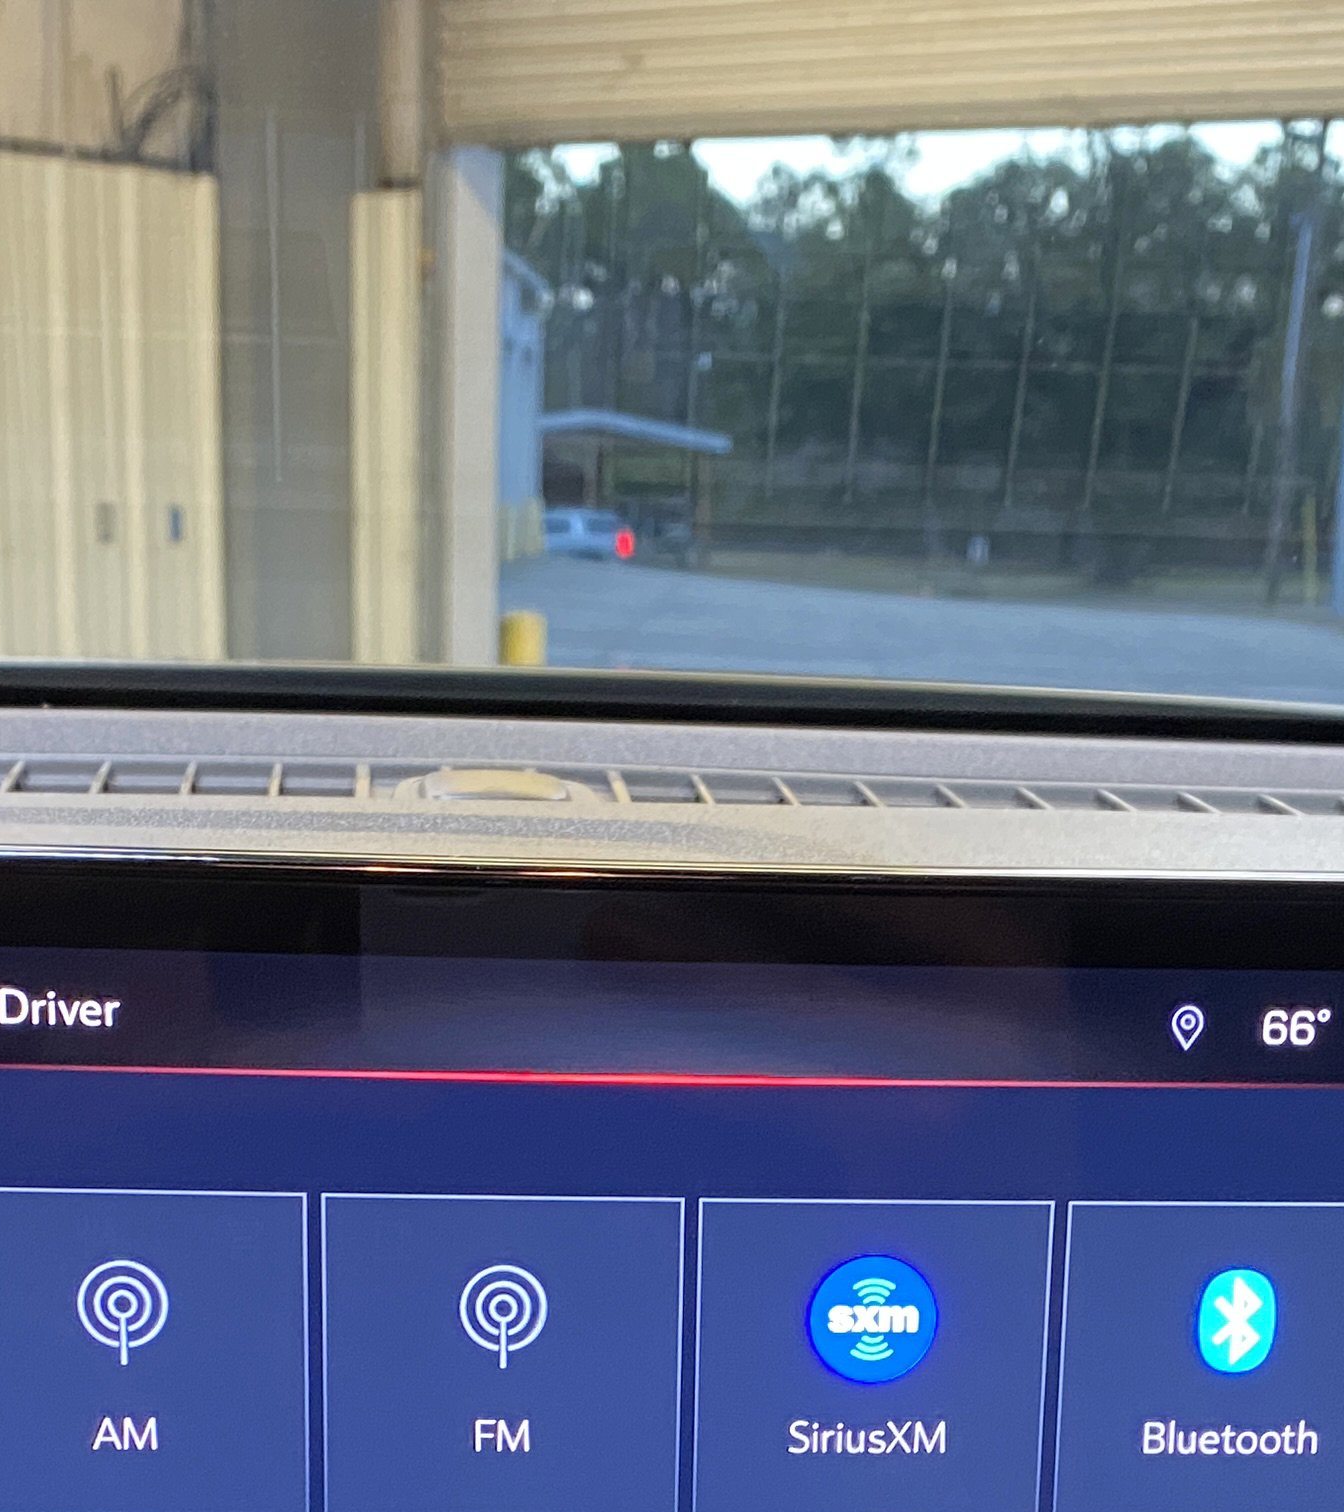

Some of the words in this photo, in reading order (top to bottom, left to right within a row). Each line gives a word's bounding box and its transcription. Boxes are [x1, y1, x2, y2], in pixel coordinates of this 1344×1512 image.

[1261, 1008, 1333, 1047] 66°
[827, 1304, 920, 1334] sxm
[92, 1416, 158, 1452] AM
[473, 1418, 532, 1453] FM
[787, 1419, 947, 1455] SiriusXM
[1141, 1419, 1319, 1456] Bluetooth
